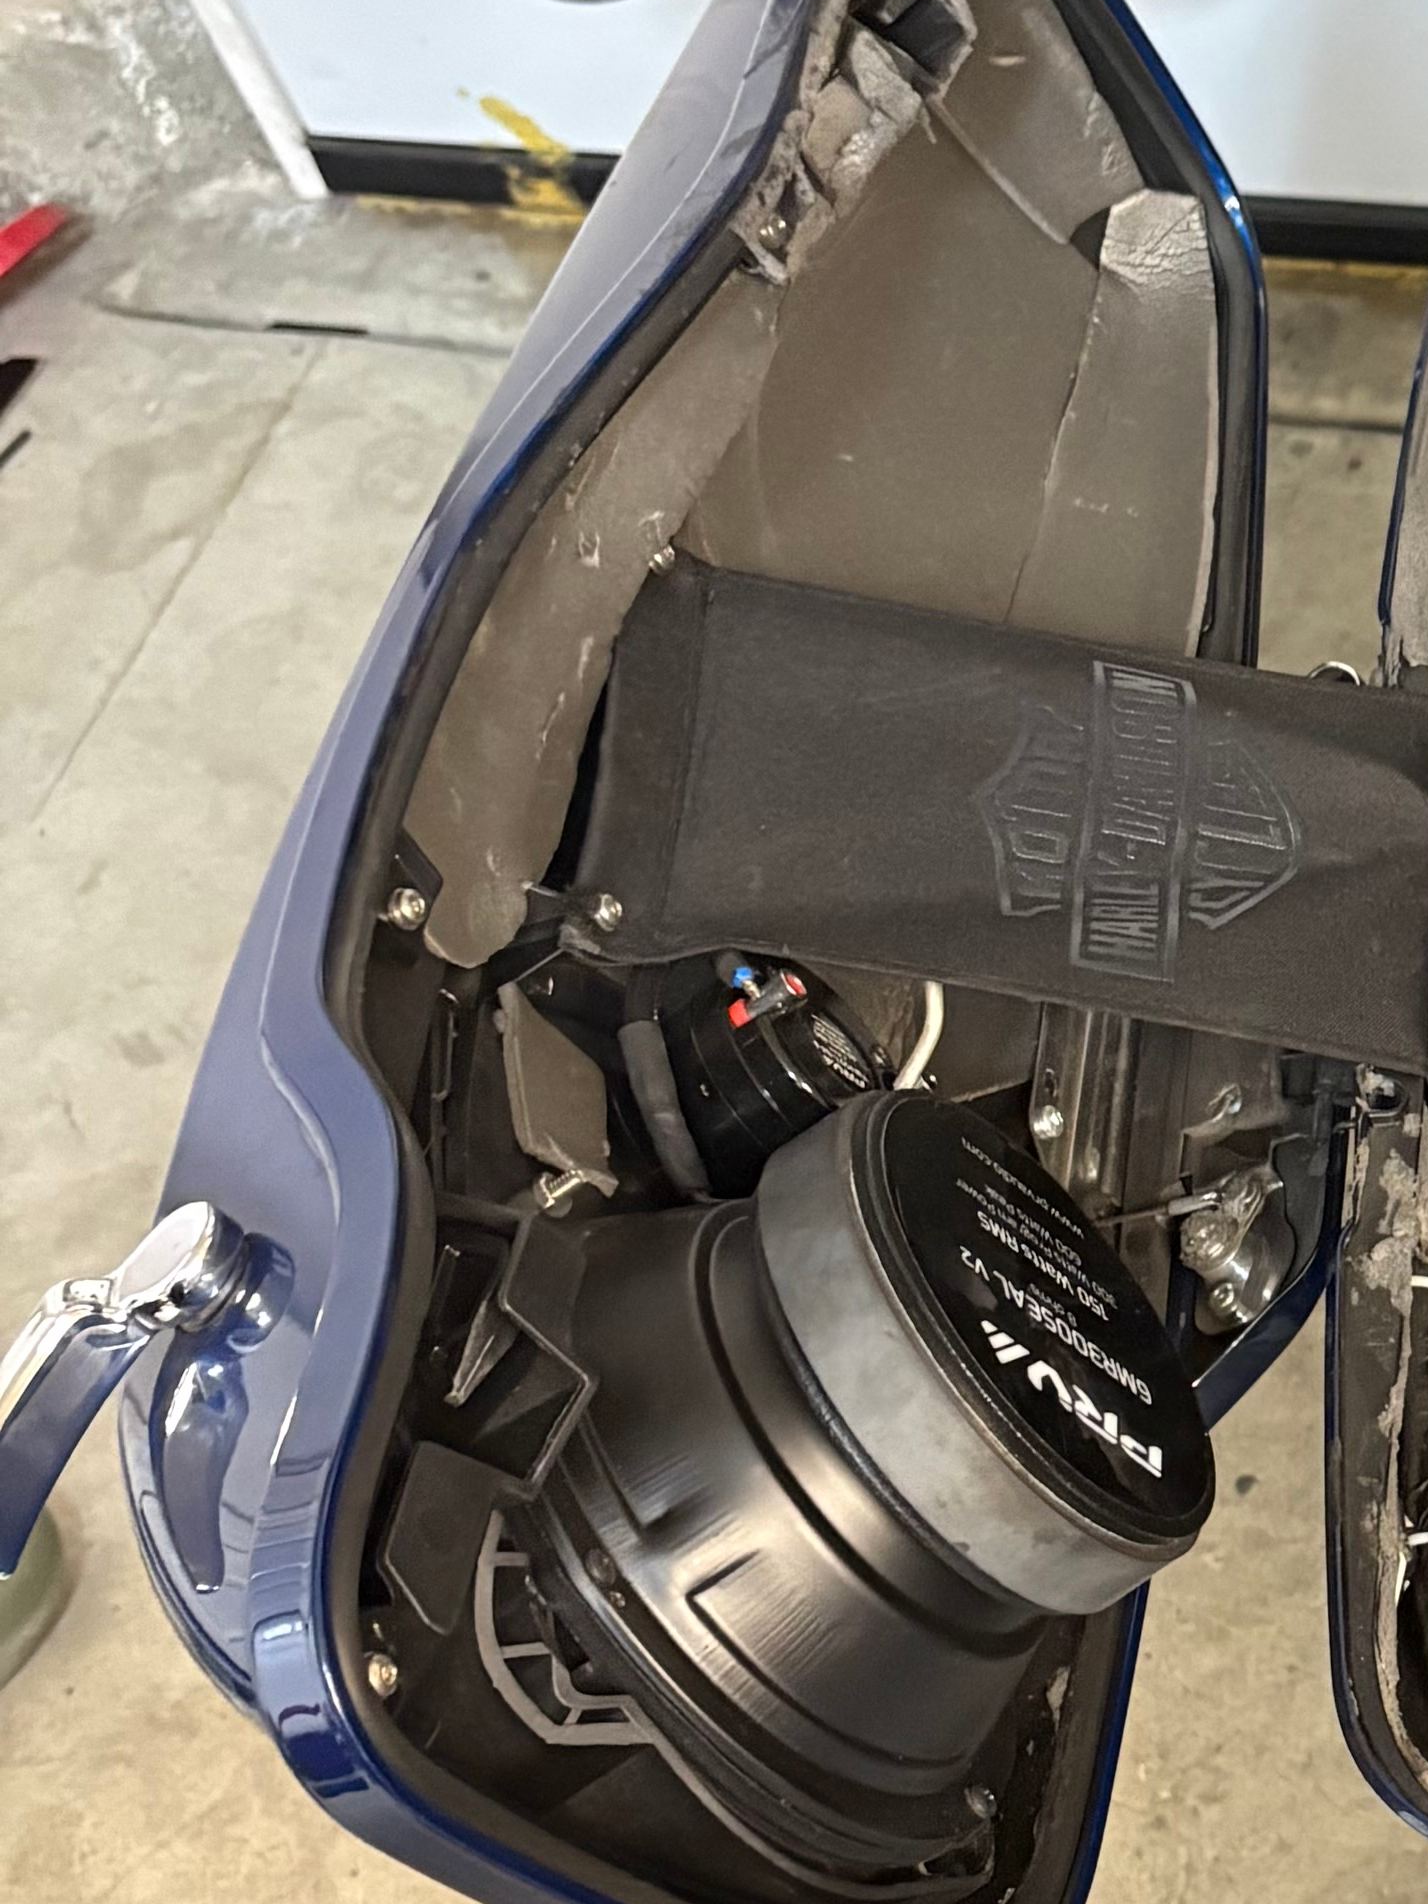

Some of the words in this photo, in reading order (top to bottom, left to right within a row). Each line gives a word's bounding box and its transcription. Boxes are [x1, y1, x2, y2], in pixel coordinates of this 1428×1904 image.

[977, 1210, 1019, 1253] RMS
[959, 1245, 991, 1282] V2
[1021, 1243, 1074, 1296] Watts
[1076, 1285, 1110, 1322] 150
[993, 1270, 1153, 1405] 6MR300SEAL
[1026, 1359, 1164, 1478] PRV
